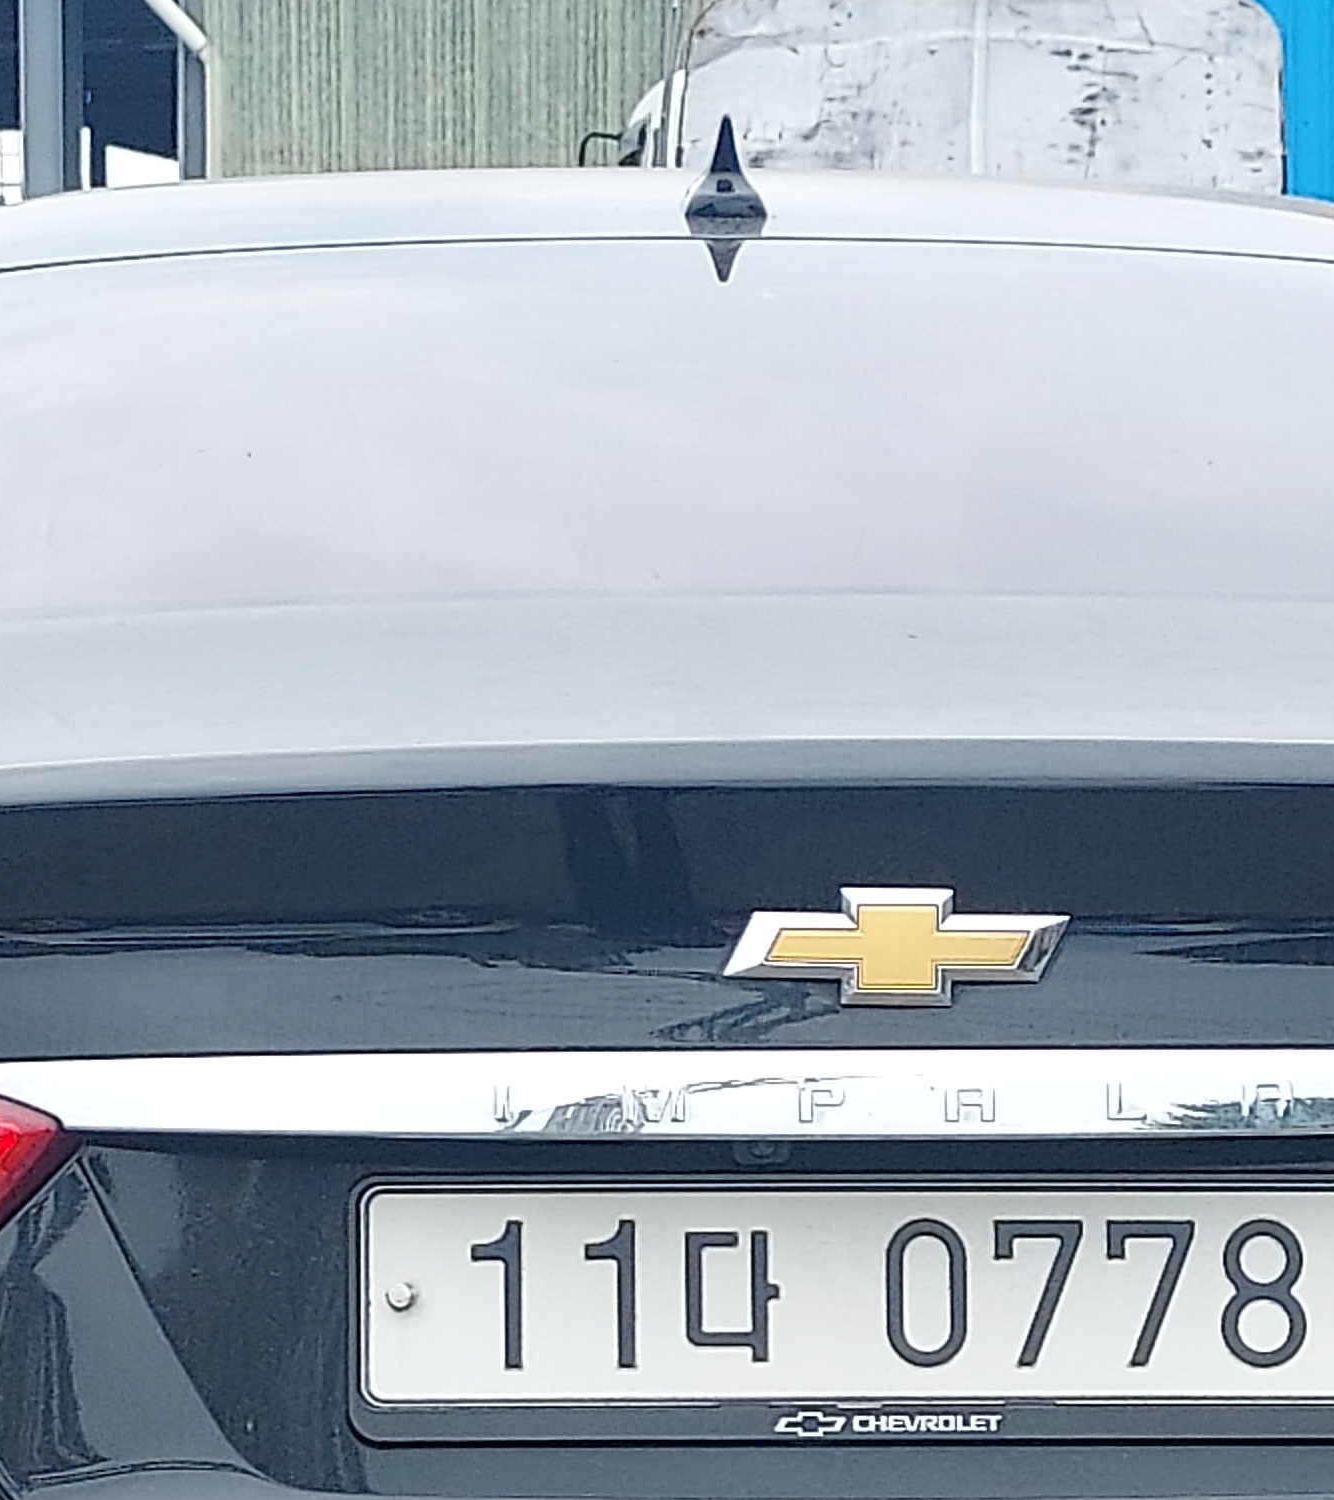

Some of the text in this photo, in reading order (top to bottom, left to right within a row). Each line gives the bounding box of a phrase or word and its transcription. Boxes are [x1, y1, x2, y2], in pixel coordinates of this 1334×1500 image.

[494, 1081, 1294, 1124] IMPALA
[470, 1218, 1308, 1370] 11다 0778
[852, 1415, 1003, 1432] CHEVROLET
